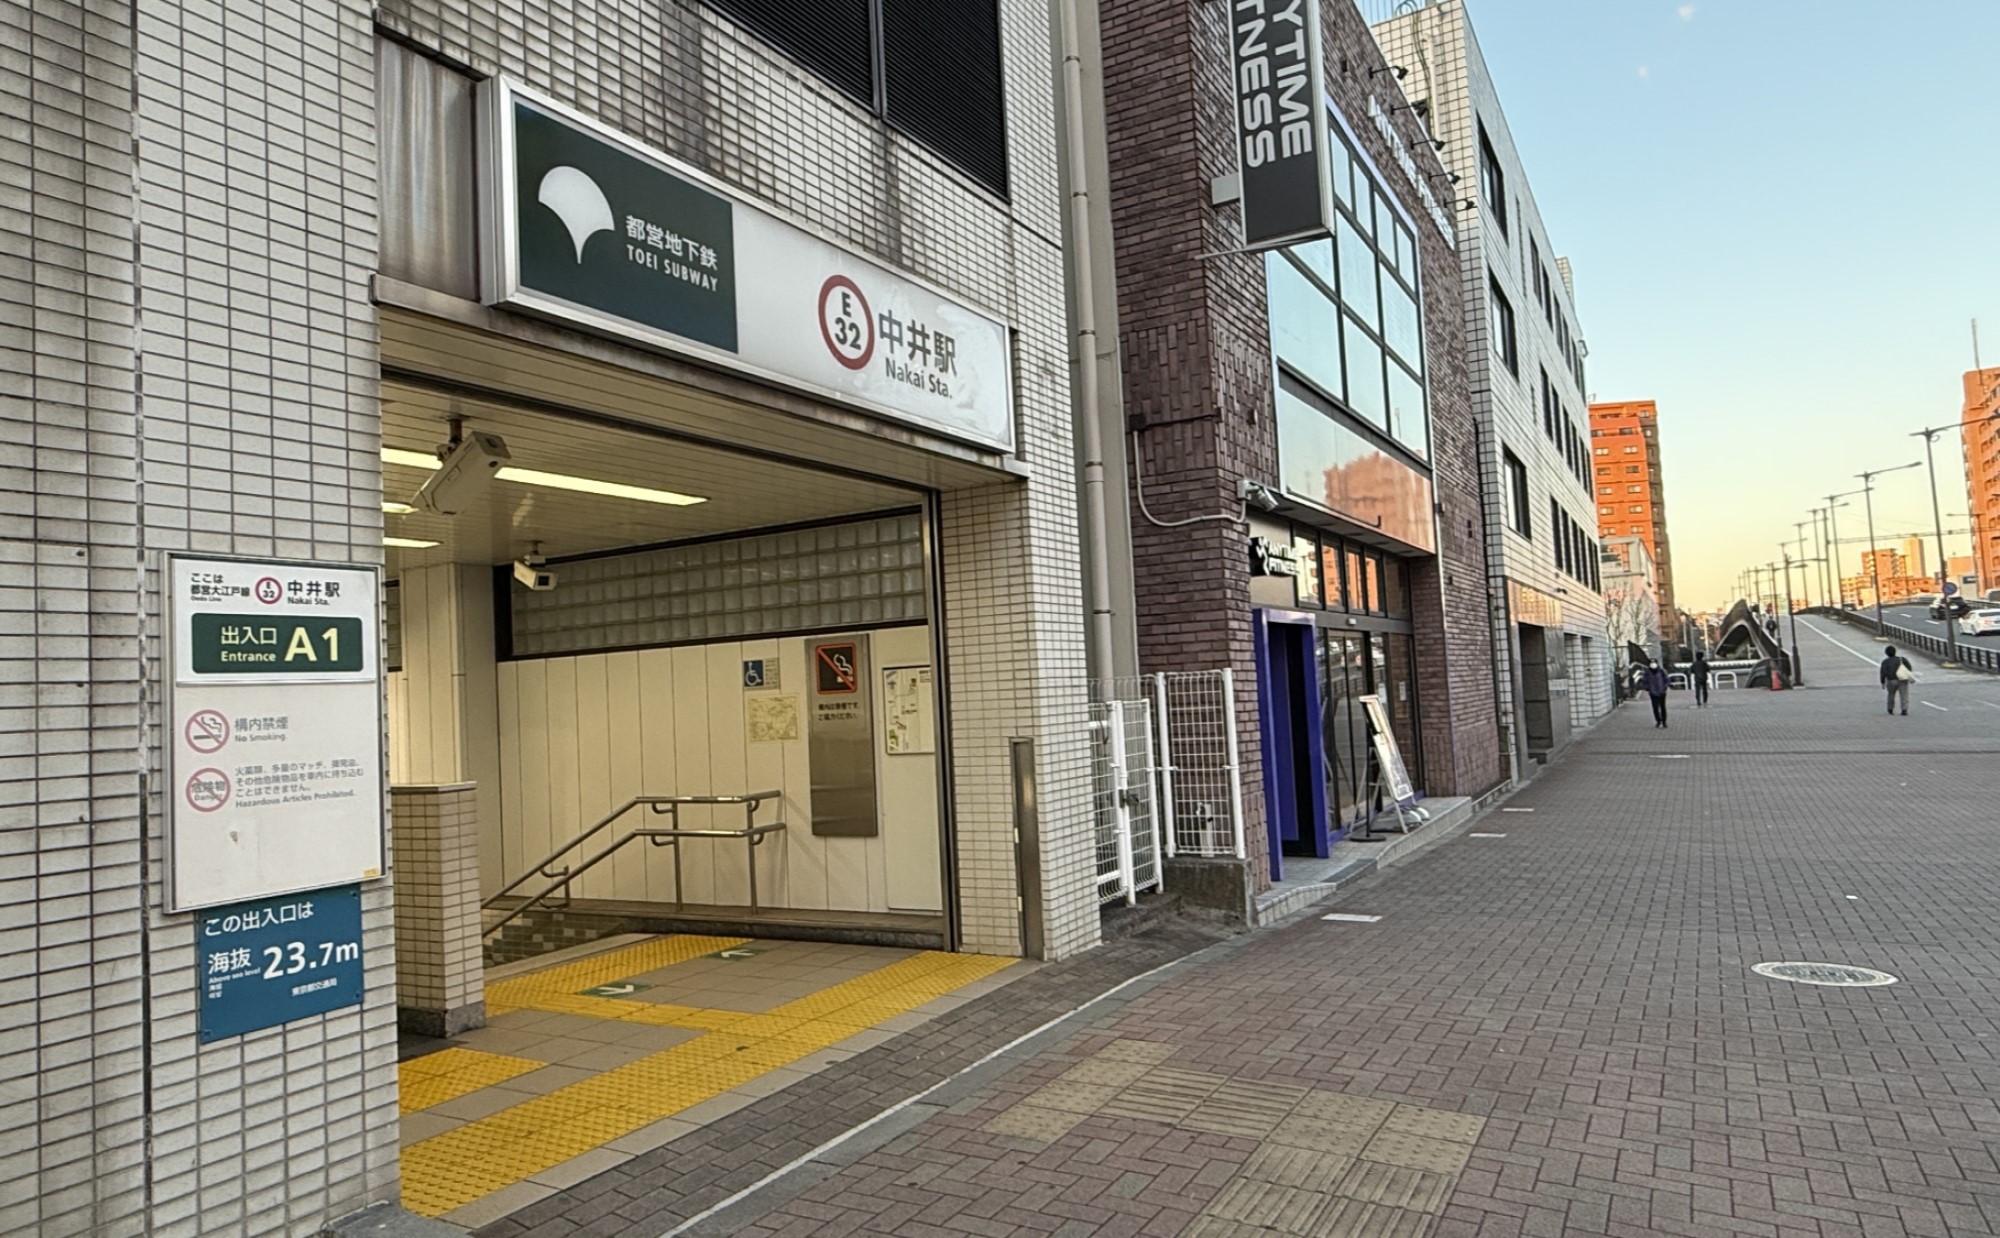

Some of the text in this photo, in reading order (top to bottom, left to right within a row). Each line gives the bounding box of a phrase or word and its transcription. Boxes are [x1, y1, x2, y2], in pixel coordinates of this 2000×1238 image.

[625, 215, 718, 270] 都営地下鉄
[626, 244, 718, 292] TOEI SUBWAY
[841, 291, 852, 318] E
[835, 317, 862, 350] 32
[878, 309, 958, 377] 中井駅
[885, 357, 953, 399] Nakai Sta.
[191, 573, 224, 584] ここは
[287, 579, 341, 598] 中井駅
[191, 584, 250, 597] 都営大江戸線
[262, 590, 275, 598] 32
[287, 596, 330, 606] Nakai Sta.
[220, 626, 278, 646] 出入口
[284, 627, 339, 662] A1
[220, 650, 277, 663] Entrance
[235, 716, 289, 731] 構内禁煙
[236, 797, 280, 808] Hazardous
[282, 793, 312, 803] Articles
[205, 901, 315, 937] この出入口は
[208, 941, 359, 979] 海抜 23.7m
[208, 974, 231, 984] Above
